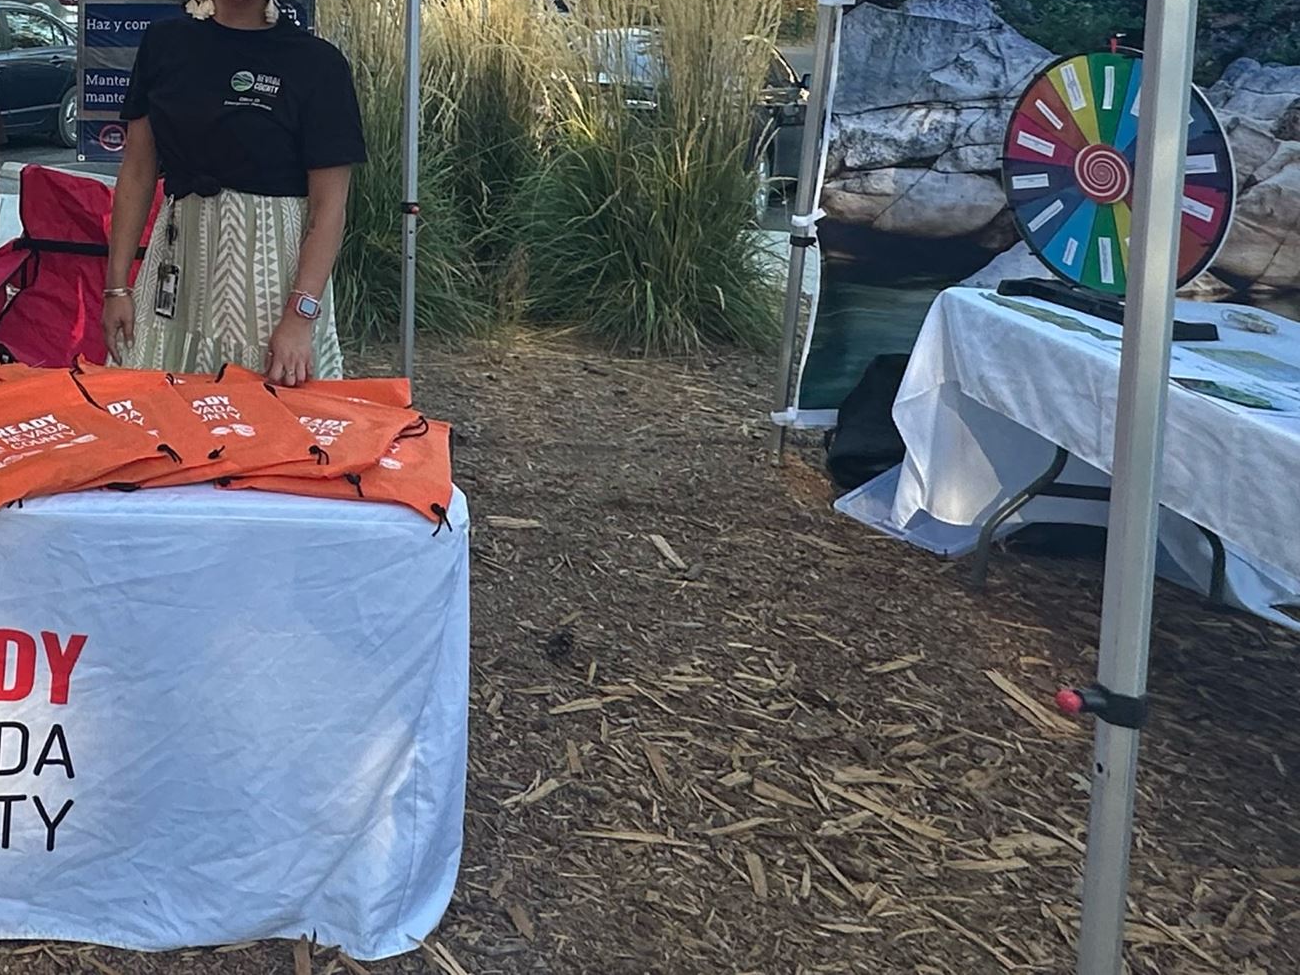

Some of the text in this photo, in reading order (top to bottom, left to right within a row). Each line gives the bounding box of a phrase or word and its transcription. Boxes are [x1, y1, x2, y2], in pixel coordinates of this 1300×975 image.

[87, 19, 150, 33] Haz y com
[86, 75, 130, 86] Mante
[86, 93, 124, 103] mante
[192, 396, 229, 408] ADY
[1, 423, 71, 445] NEVADA
[10, 430, 76, 450] COUNTY
